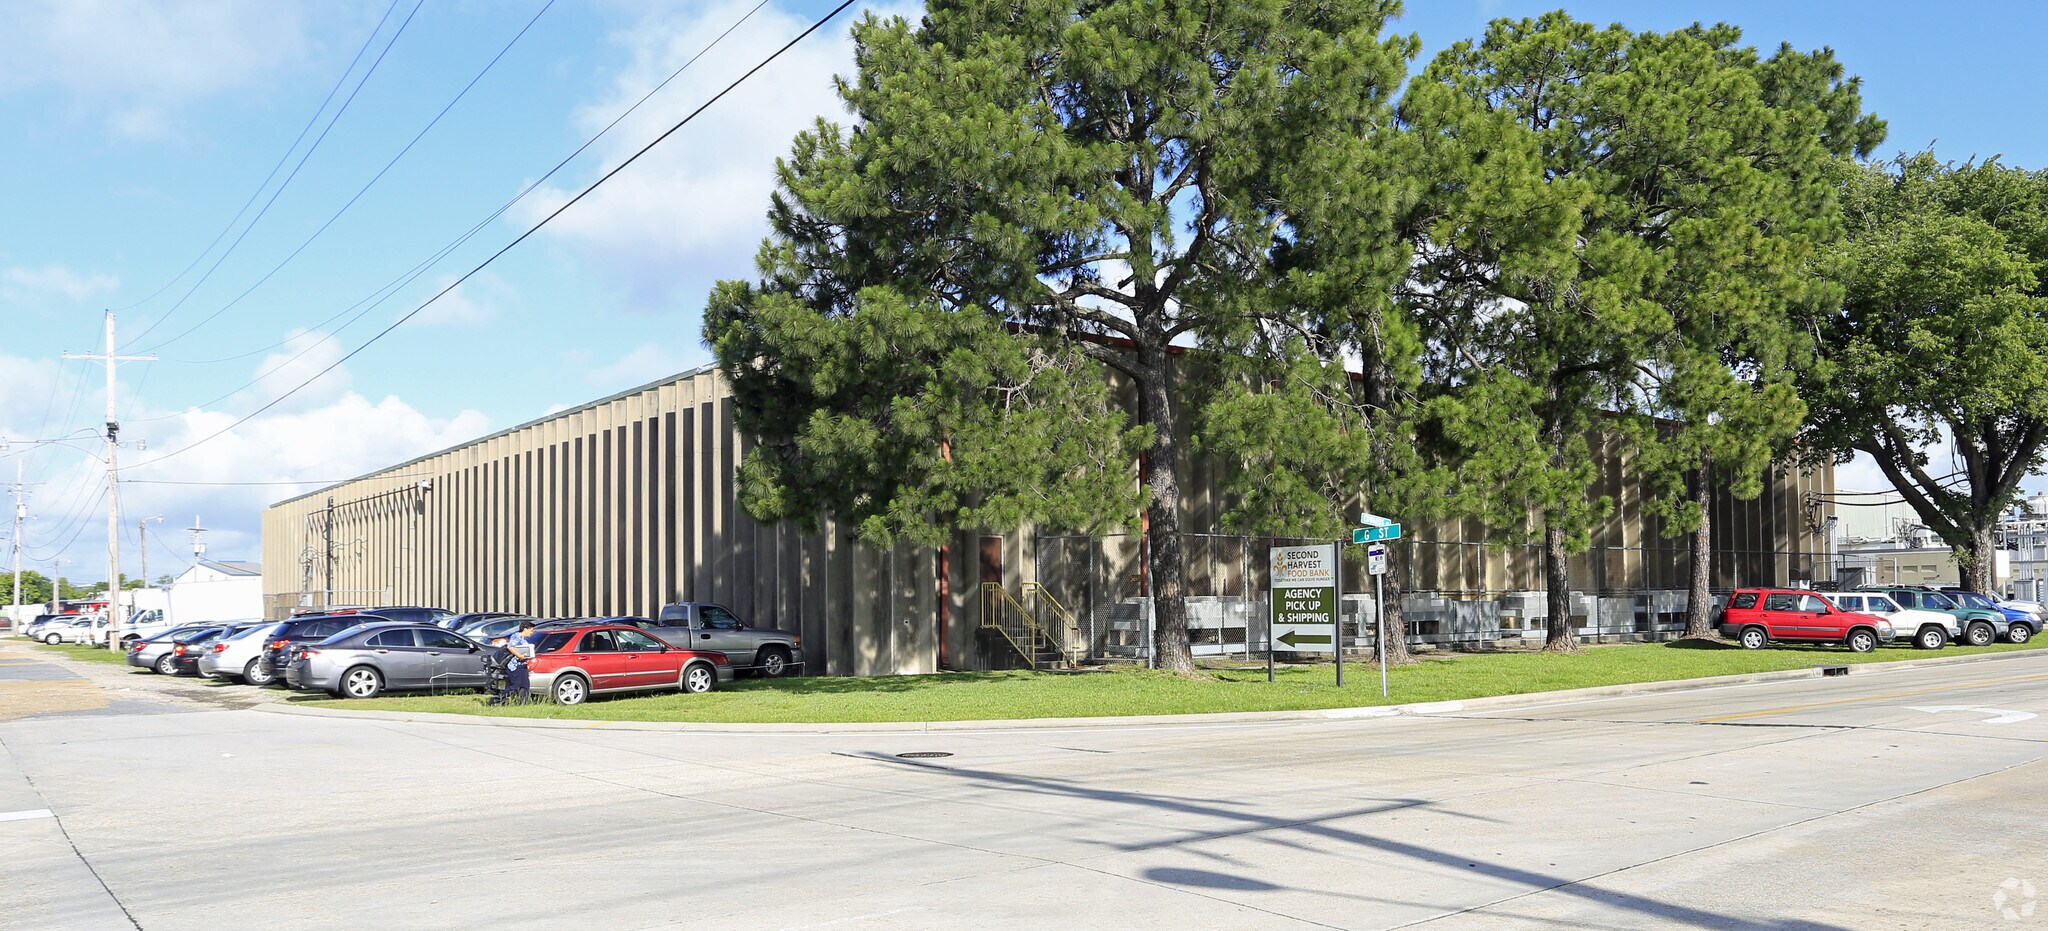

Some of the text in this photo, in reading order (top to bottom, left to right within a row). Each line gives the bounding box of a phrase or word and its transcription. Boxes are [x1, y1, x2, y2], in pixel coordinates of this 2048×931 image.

[1364, 527, 1389, 540] G ST
[1287, 550, 1319, 560] SECOND
[1287, 560, 1322, 569] HARVEST
[1287, 569, 1308, 577] FOOD
[1284, 588, 1322, 599] AGENCY
[1285, 601, 1321, 611] PICK UP
[1278, 612, 1330, 623] & SHIPPING
